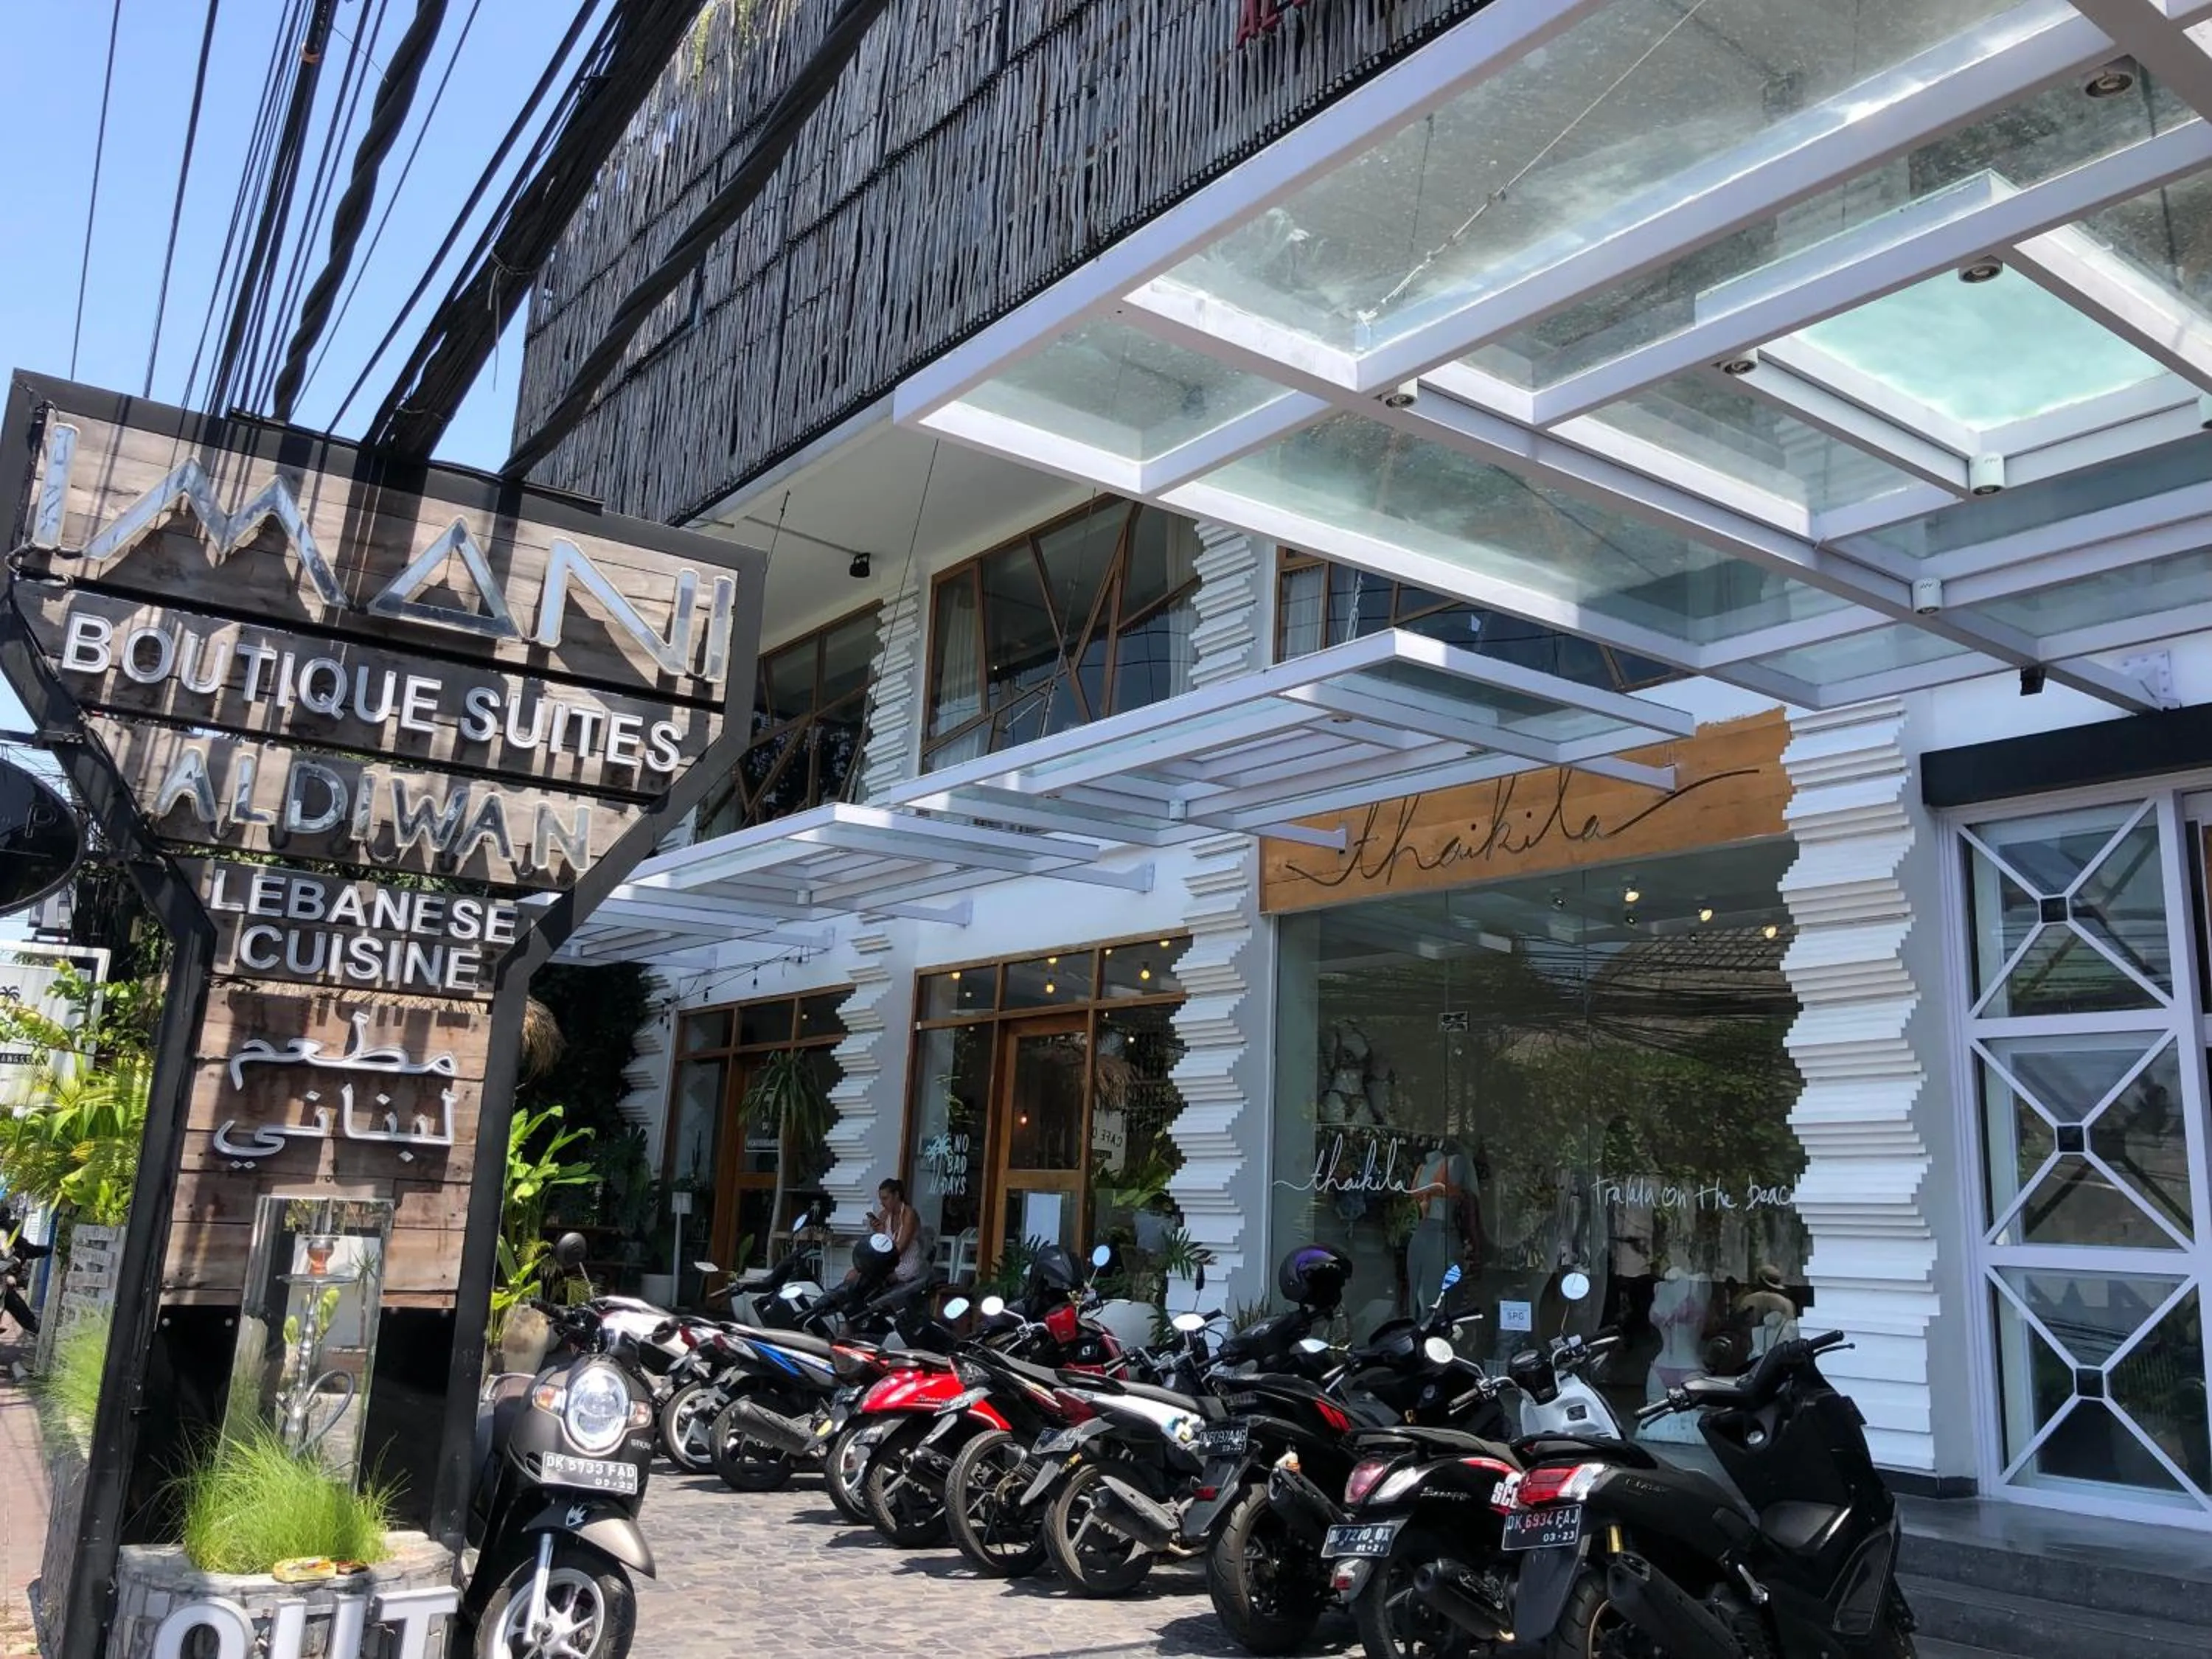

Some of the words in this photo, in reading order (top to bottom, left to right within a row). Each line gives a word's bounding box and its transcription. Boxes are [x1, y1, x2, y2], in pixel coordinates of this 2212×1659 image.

[32, 421, 737, 684] IMANI
[61, 611, 443, 733] BOUTIQUE
[459, 686, 686, 774] SUITES
[146, 746, 591, 872] ALDIWAN
[1286, 767, 1759, 886] thaikila
[209, 869, 518, 945] LEBANESE
[239, 924, 483, 991] CUISINE
[229, 1011, 459, 1091] مطعم
[213, 1082, 459, 1169] لبناني
[953, 1133, 970, 1152] NO
[941, 1175, 967, 1195] DAYS
[947, 1155, 968, 1175] BAD
[1273, 1133, 1445, 1193] thaikila
[1661, 1186, 1687, 1209] on
[1745, 1174, 1800, 1211] beac
[546, 1455, 565, 1471] DK
[608, 1464, 635, 1477] FAD
[1506, 1515, 1523, 1531] DK
[1555, 1509, 1579, 1526] FAJ
